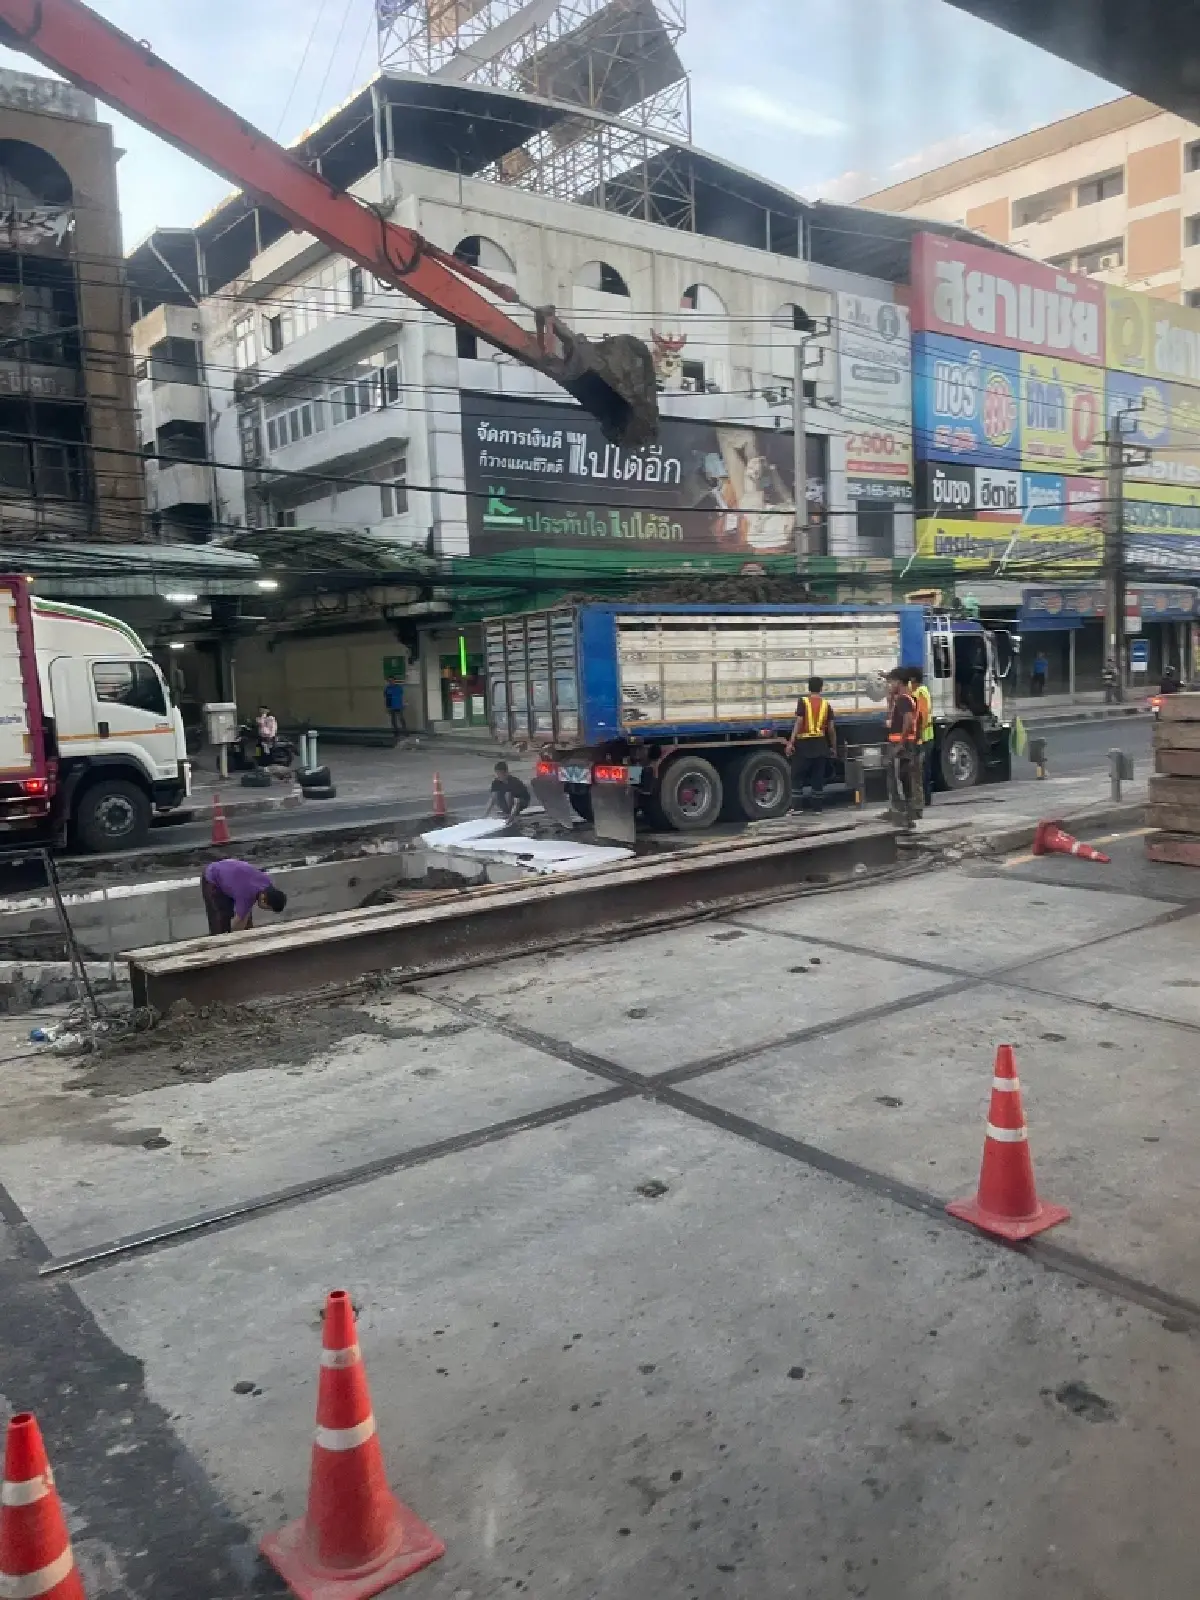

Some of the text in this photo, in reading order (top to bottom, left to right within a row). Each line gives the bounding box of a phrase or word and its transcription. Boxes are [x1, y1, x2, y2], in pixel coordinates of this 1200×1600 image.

[934, 261, 1099, 356] สยามชัย
[477, 421, 563, 449] จัดการเงินดี
